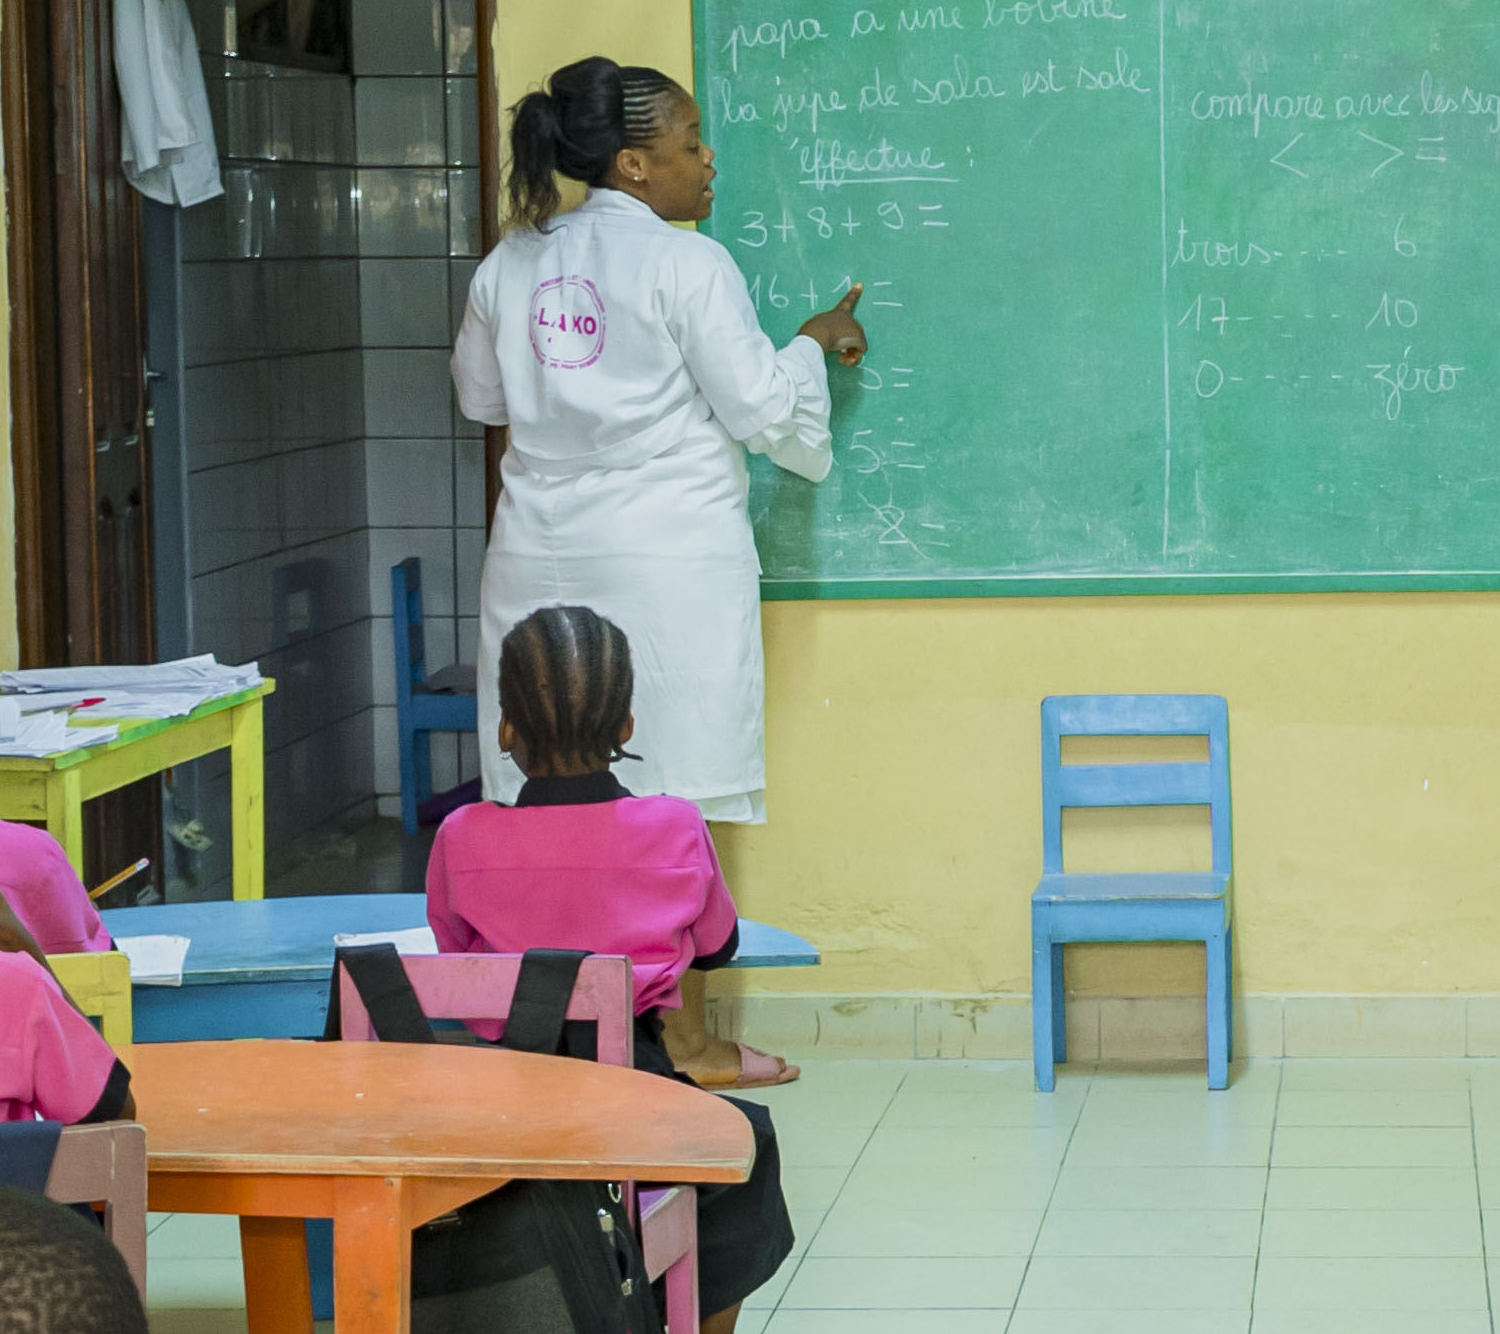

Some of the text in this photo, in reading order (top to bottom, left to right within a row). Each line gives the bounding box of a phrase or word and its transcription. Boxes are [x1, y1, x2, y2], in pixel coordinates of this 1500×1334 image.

[721, 16, 829, 73] papa
[851, 8, 885, 39] a
[898, 5, 963, 33] une
[720, 47, 1151, 134] la jupe de sala est sale
[1191, 89, 1326, 138] compare
[1335, 91, 1410, 117] avec
[1419, 71, 1459, 115] les
[1394, 212, 1417, 257] 6
[1365, 291, 1418, 329] 10
[1366, 346, 1465, 420] zéro
